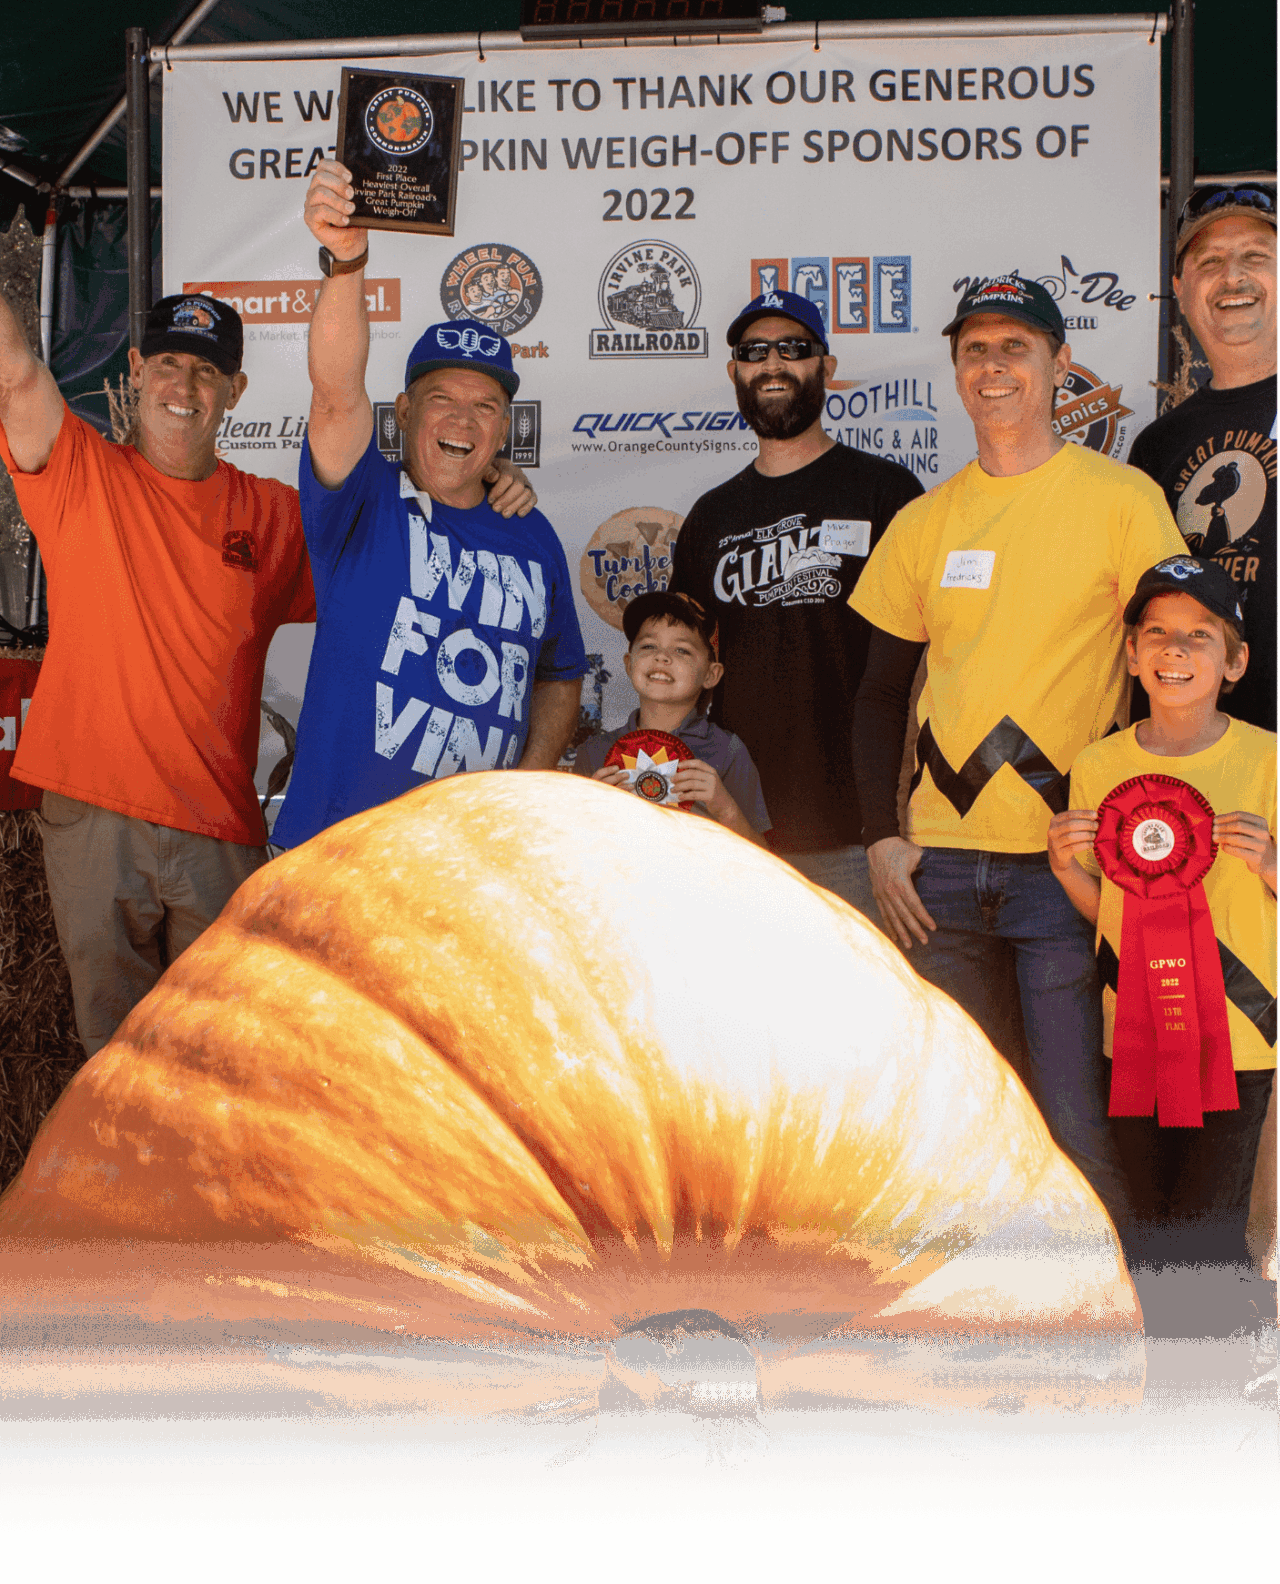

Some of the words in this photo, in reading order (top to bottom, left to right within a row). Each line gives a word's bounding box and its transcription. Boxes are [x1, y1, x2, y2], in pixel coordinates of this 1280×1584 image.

[222, 90, 284, 123] WE
[548, 78, 601, 112] TO
[612, 73, 753, 110] THANK
[765, 68, 856, 105] OUR
[868, 64, 1096, 102] GENEROUS
[370, 90, 394, 112] GREAT
[398, 89, 431, 119] PUMPKIN
[369, 125, 429, 151] COMMONWEALTH
[229, 145, 337, 180] GREA
[458, 137, 548, 172] PKIN
[561, 130, 790, 170] WEIGH-OFF
[802, 125, 1023, 164] SPONSORS
[1035, 123, 1090, 159] OF
[376, 171, 393, 181] First
[395, 173, 417, 183] Place
[387, 164, 408, 174] 2022
[354, 187, 377, 197] Irvine
[378, 189, 396, 199] Park
[398, 191, 437, 202] Railroad's
[362, 179, 398, 190] Heaviest
[400, 182, 430, 193] Overall
[365, 196, 388, 207] Great
[390, 198, 425, 210] Pumpkin
[373, 205, 417, 218] Weigh-Off
[602, 187, 696, 221] 2022
[446, 247, 502, 288] WHEEL
[506, 252, 537, 287] FUN
[608, 248, 654, 291] IRVINE
[659, 250, 693, 289] PARK
[761, 292, 784, 309] LA
[447, 298, 532, 333] RETALS
[511, 340, 550, 360] Park
[596, 332, 700, 352] RAILROAD
[826, 378, 938, 421] OOTHILL
[217, 439, 278, 450] Custom
[571, 439, 758, 454] www.OrangeCountySigns.co
[825, 426, 884, 450] ATING
[892, 428, 902, 450] &
[911, 426, 938, 450] AIR
[514, 452, 533, 461] 1999
[1173, 436, 1215, 492] GREAT
[756, 529, 775, 541] ELK
[777, 516, 803, 533] GROVE
[827, 523, 850, 532] Mike
[408, 512, 548, 640] WIN
[606, 569, 668, 602] Cooki
[759, 580, 794, 603] PUMPKIN
[793, 568, 832, 586] FESTIVAL
[380, 595, 530, 723] FOR
[1149, 957, 1187, 970] GPWO
